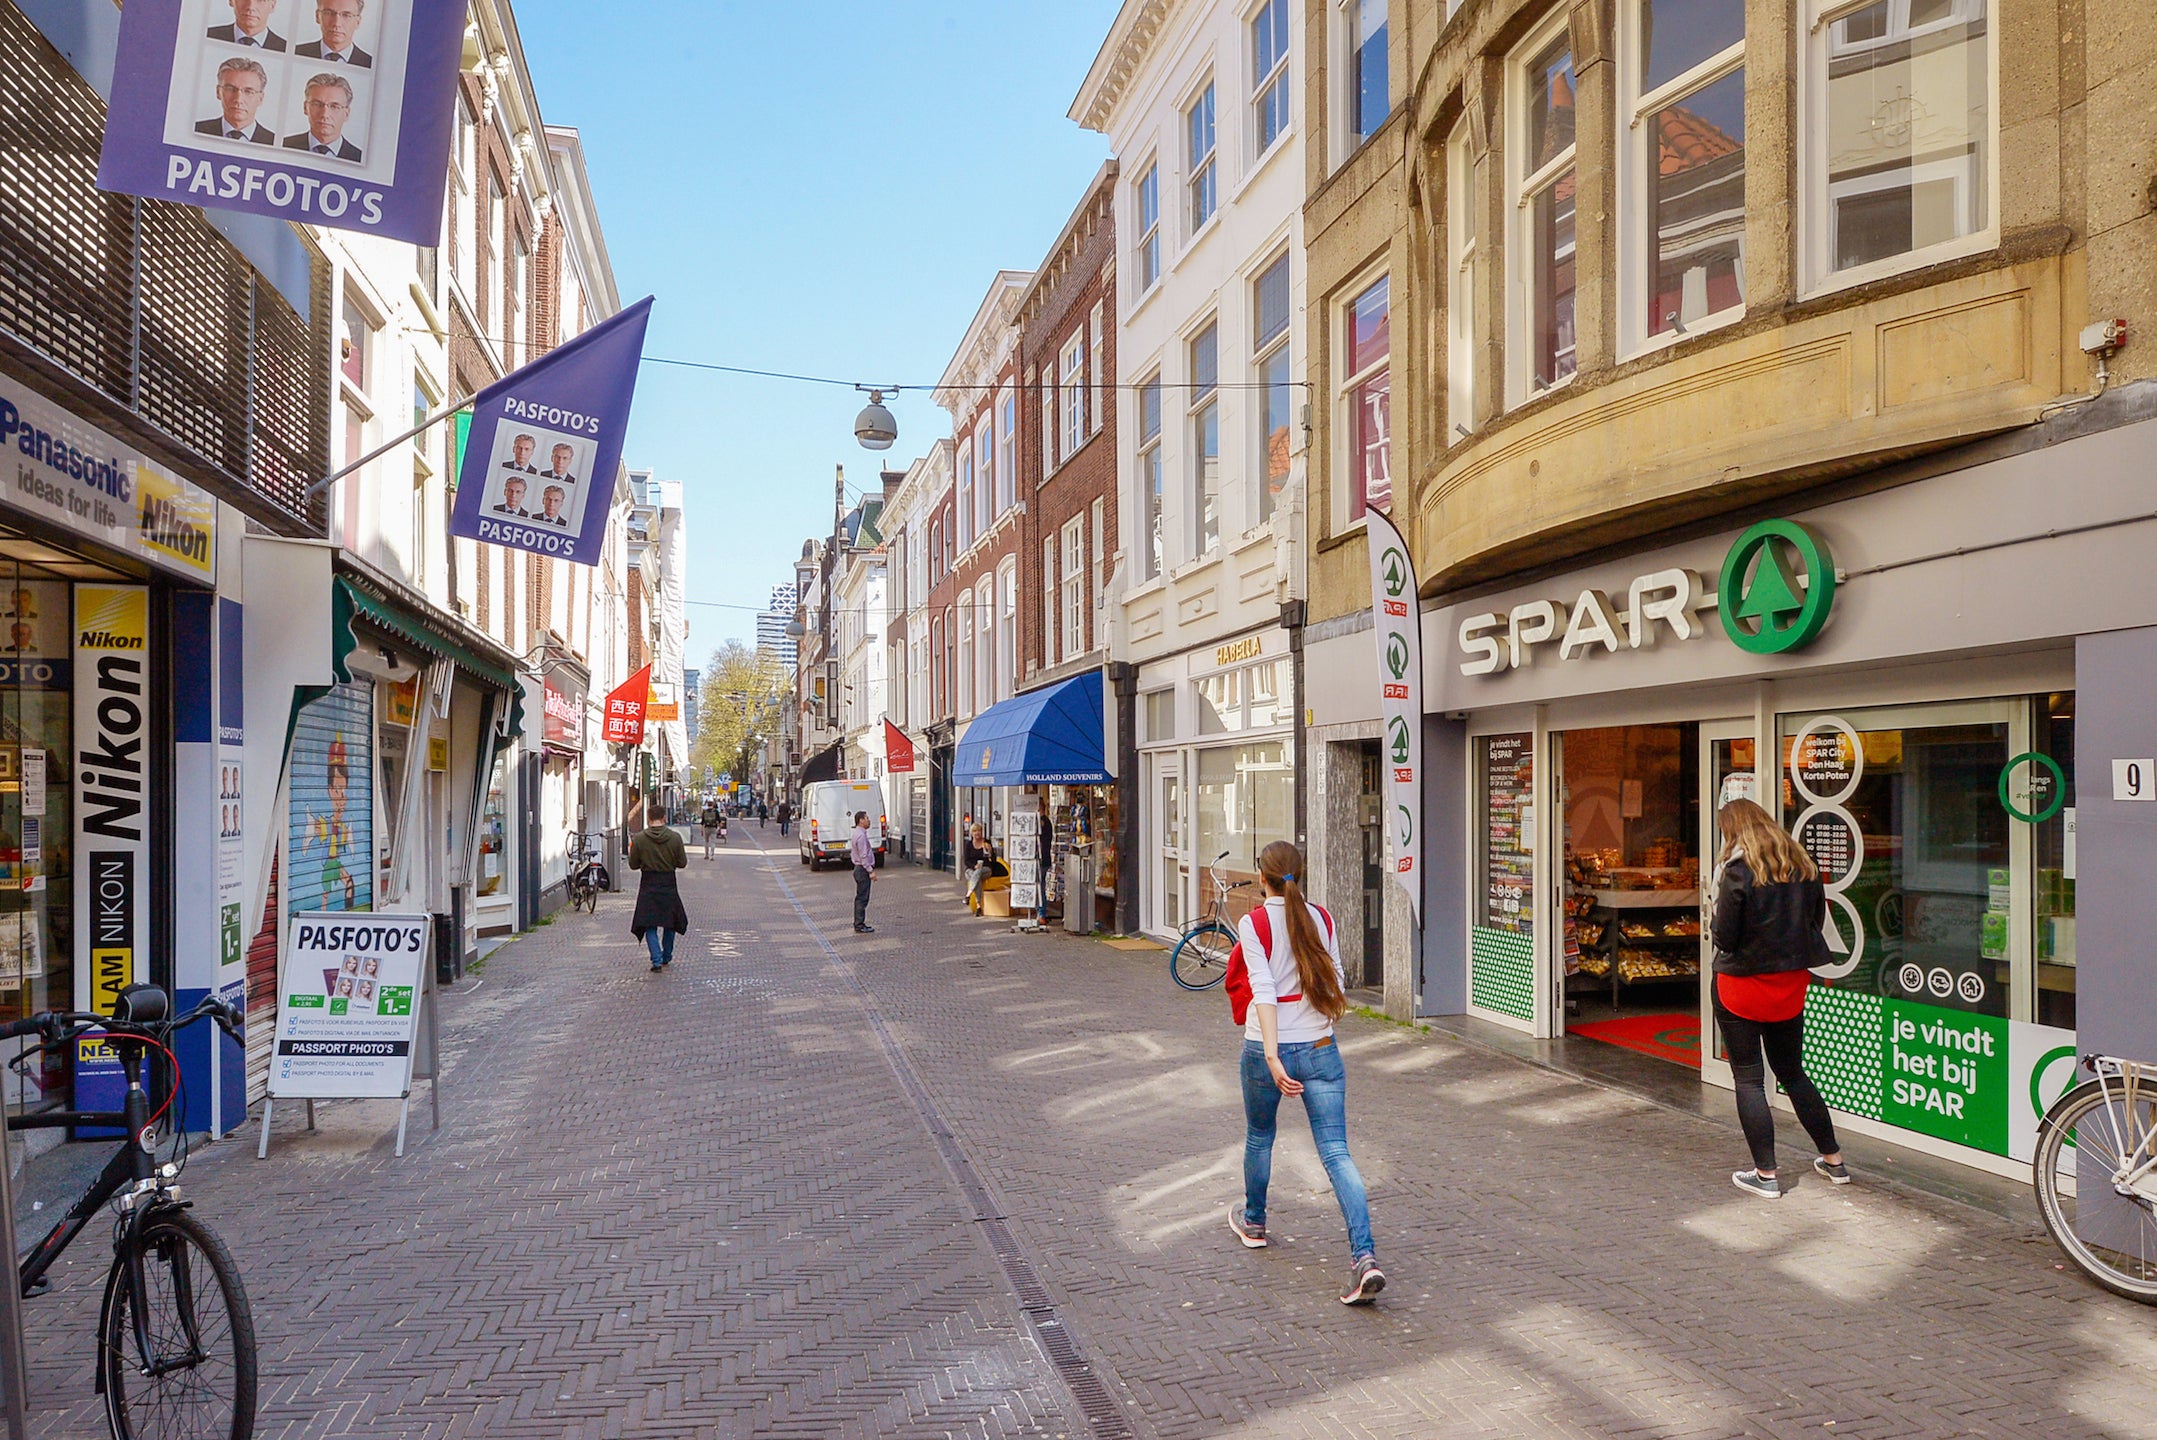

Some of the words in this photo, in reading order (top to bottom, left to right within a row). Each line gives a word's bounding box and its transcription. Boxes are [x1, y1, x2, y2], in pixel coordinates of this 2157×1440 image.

[166, 154, 384, 225] PASFOTO'S
[504, 397, 599, 434] PASFOTO'S
[0, 396, 131, 503] Panasonic
[17, 463, 64, 508] ideas
[67, 487, 91, 517] for
[94, 498, 117, 530] life
[140, 492, 208, 563] Nikon
[478, 520, 575, 556] PASFOTO'S
[1458, 567, 1704, 677] SPAR
[79, 631, 143, 650] Nikon
[1217, 636, 1262, 666] HABELLA
[608, 717, 639, 734] 面馆
[610, 699, 641, 716] 西安
[79, 655, 142, 842] Nikon
[1498, 750, 1513, 759] SPAR
[1806, 738, 1835, 746] welkom
[1836, 736, 1846, 747] bij
[1806, 748, 1828, 758] SPAR
[1829, 747, 1846, 758] City
[1026, 773, 1061, 781] HOLLAND
[1062, 773, 1103, 781] SOUVENIRS
[1803, 772, 1824, 780] Korte
[1825, 771, 1849, 780] Poten
[1807, 761, 1823, 769] Den
[1824, 760, 1845, 770] Haag
[2126, 762, 2141, 798] 9
[100, 862, 124, 941] NIKON
[298, 926, 421, 952] PASFOTO'S
[292, 1042, 347, 1054] PASSPORT
[349, 1043, 394, 1054] PHOTO'S
[1890, 1011, 1916, 1043] je
[1920, 1019, 1995, 1057] vindt
[1893, 1044, 1938, 1079] het
[1943, 1055, 1977, 1095] bij
[1893, 1079, 1964, 1120] SPAR
